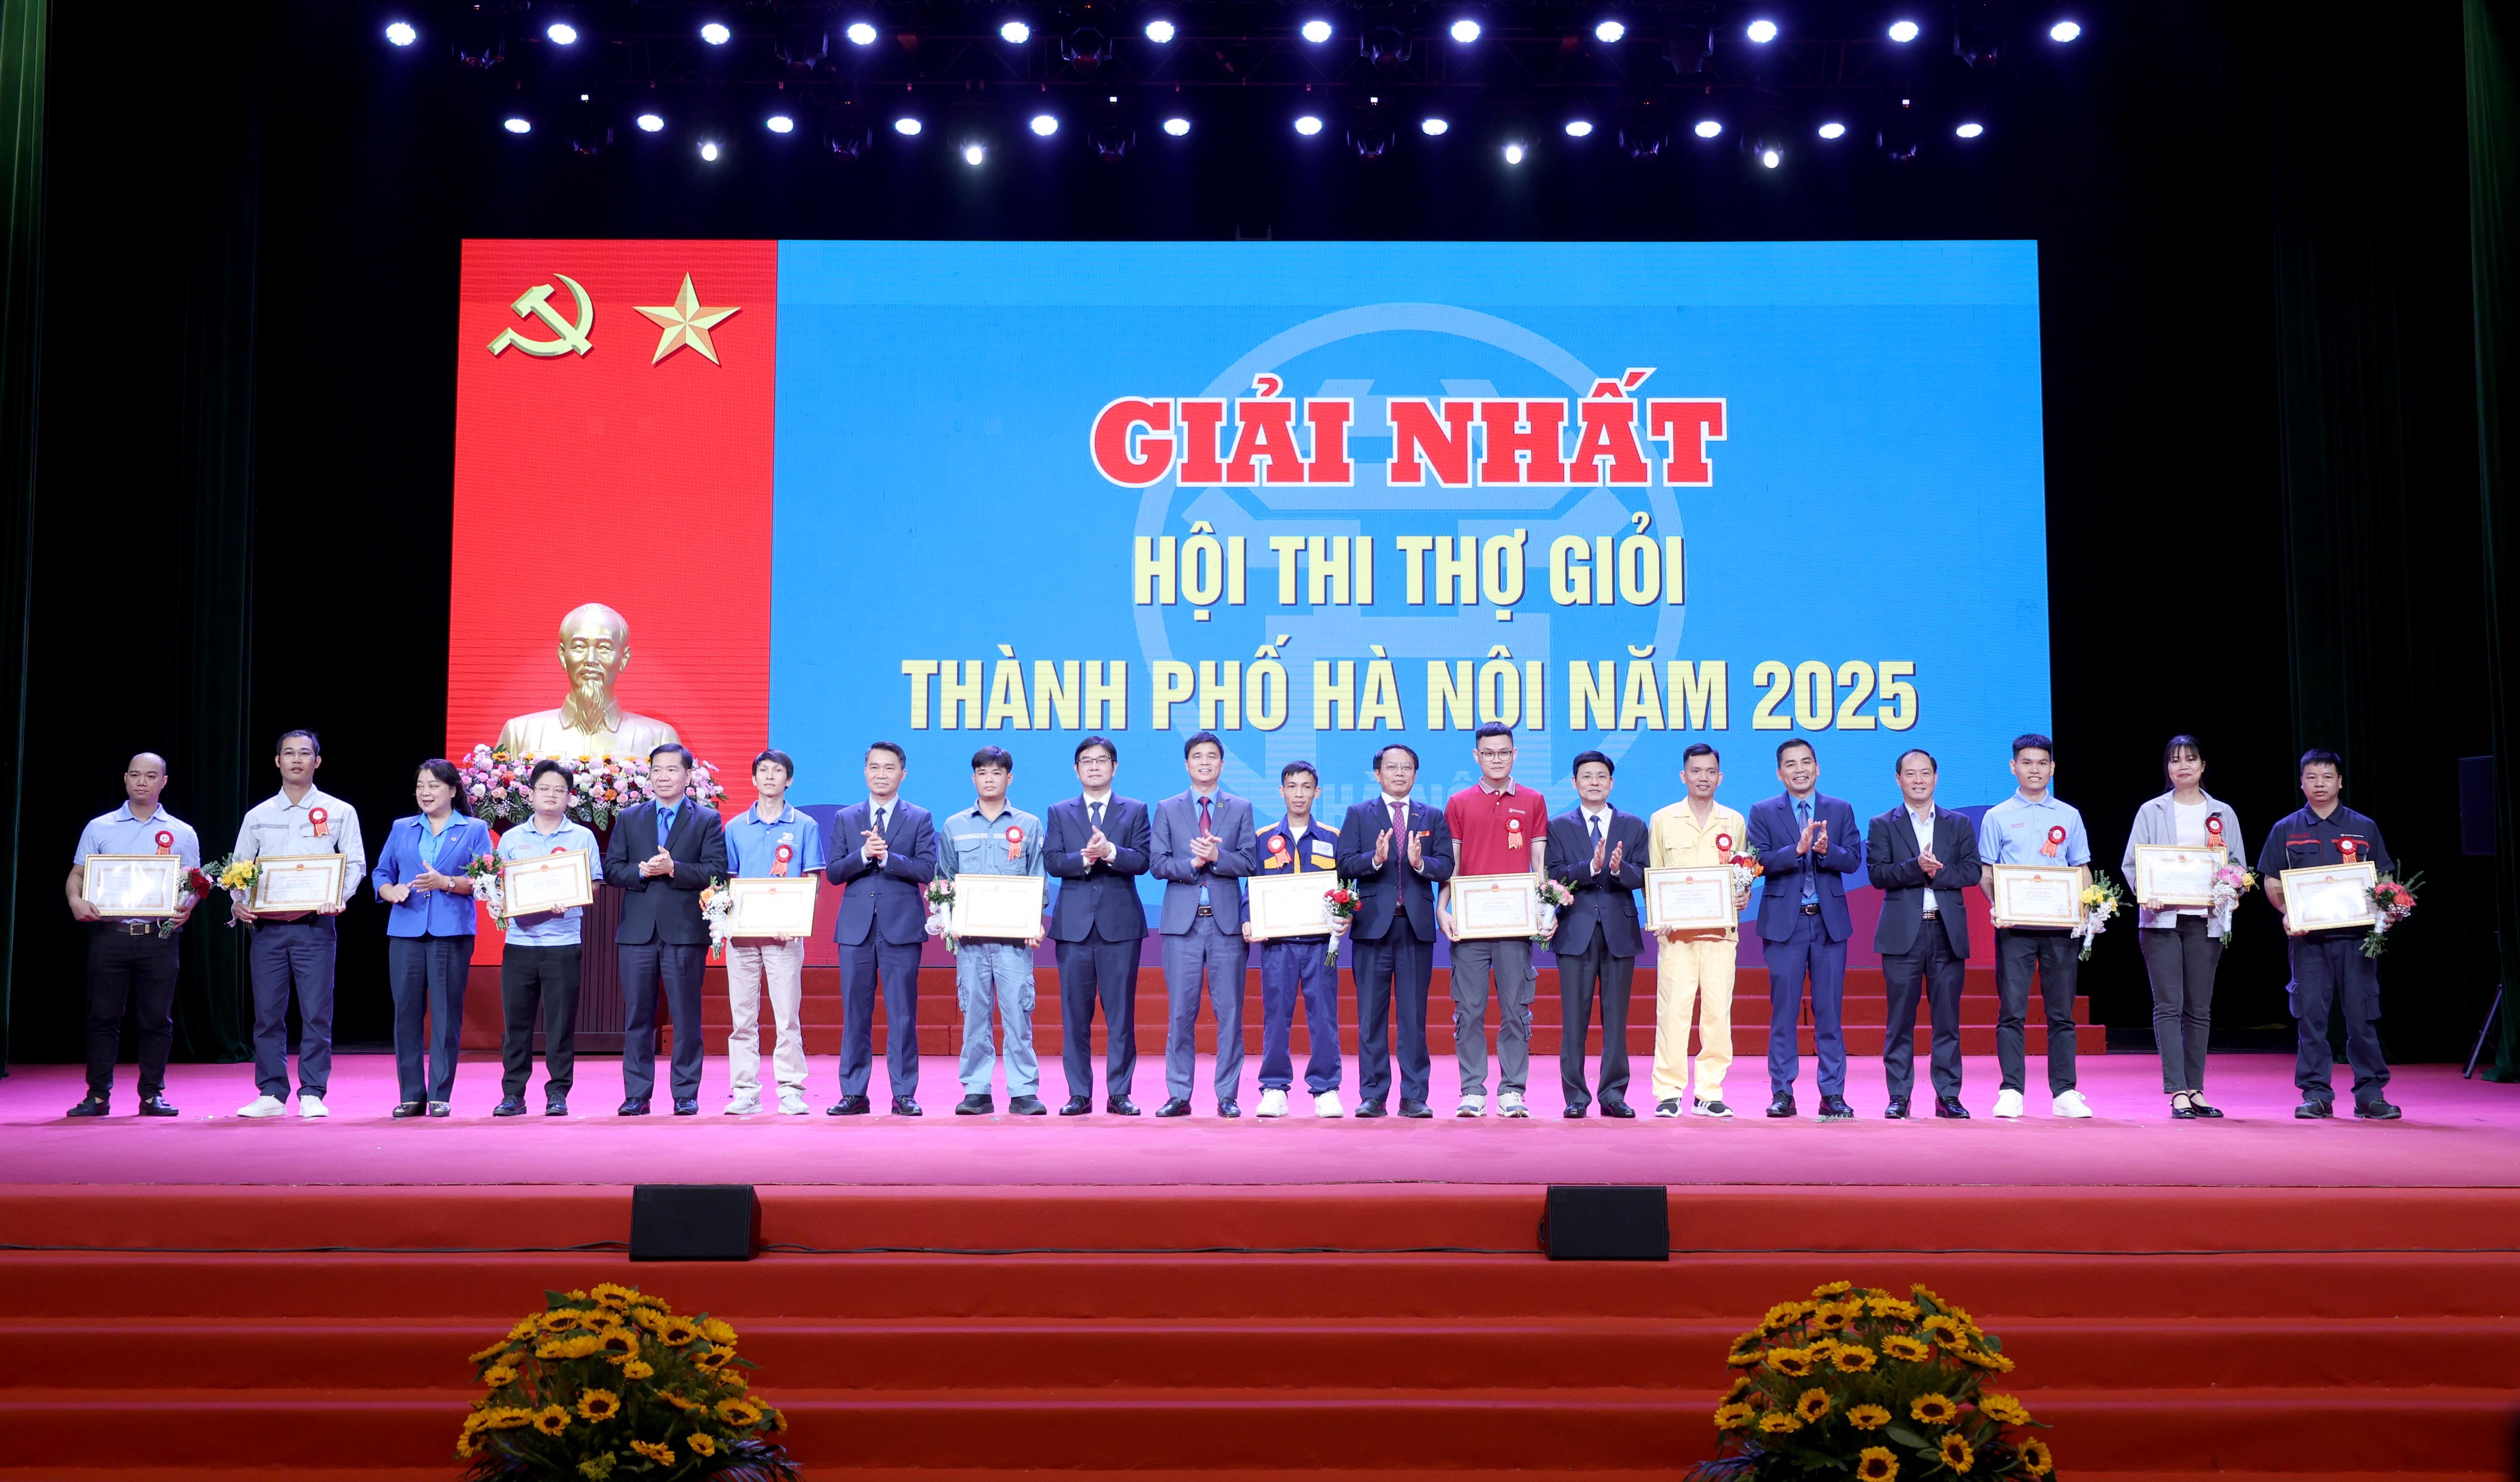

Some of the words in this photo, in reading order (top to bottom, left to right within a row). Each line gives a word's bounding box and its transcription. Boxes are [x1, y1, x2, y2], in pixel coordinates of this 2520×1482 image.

[1090, 373, 1354, 488] GIẢI
[1387, 367, 1728, 488] NHẤT
[1135, 520, 1245, 621] HỘI
[1270, 536, 1374, 605] THI
[1396, 528, 1526, 621] THỢ
[1549, 511, 1684, 605] GIỎI
[901, 644, 1128, 730] THÀNH
[1153, 634, 1292, 732] PHỐ
[1313, 645, 1405, 731] HÀ
[1569, 645, 1728, 731] NĂM
[1753, 661, 1918, 731] 2025
